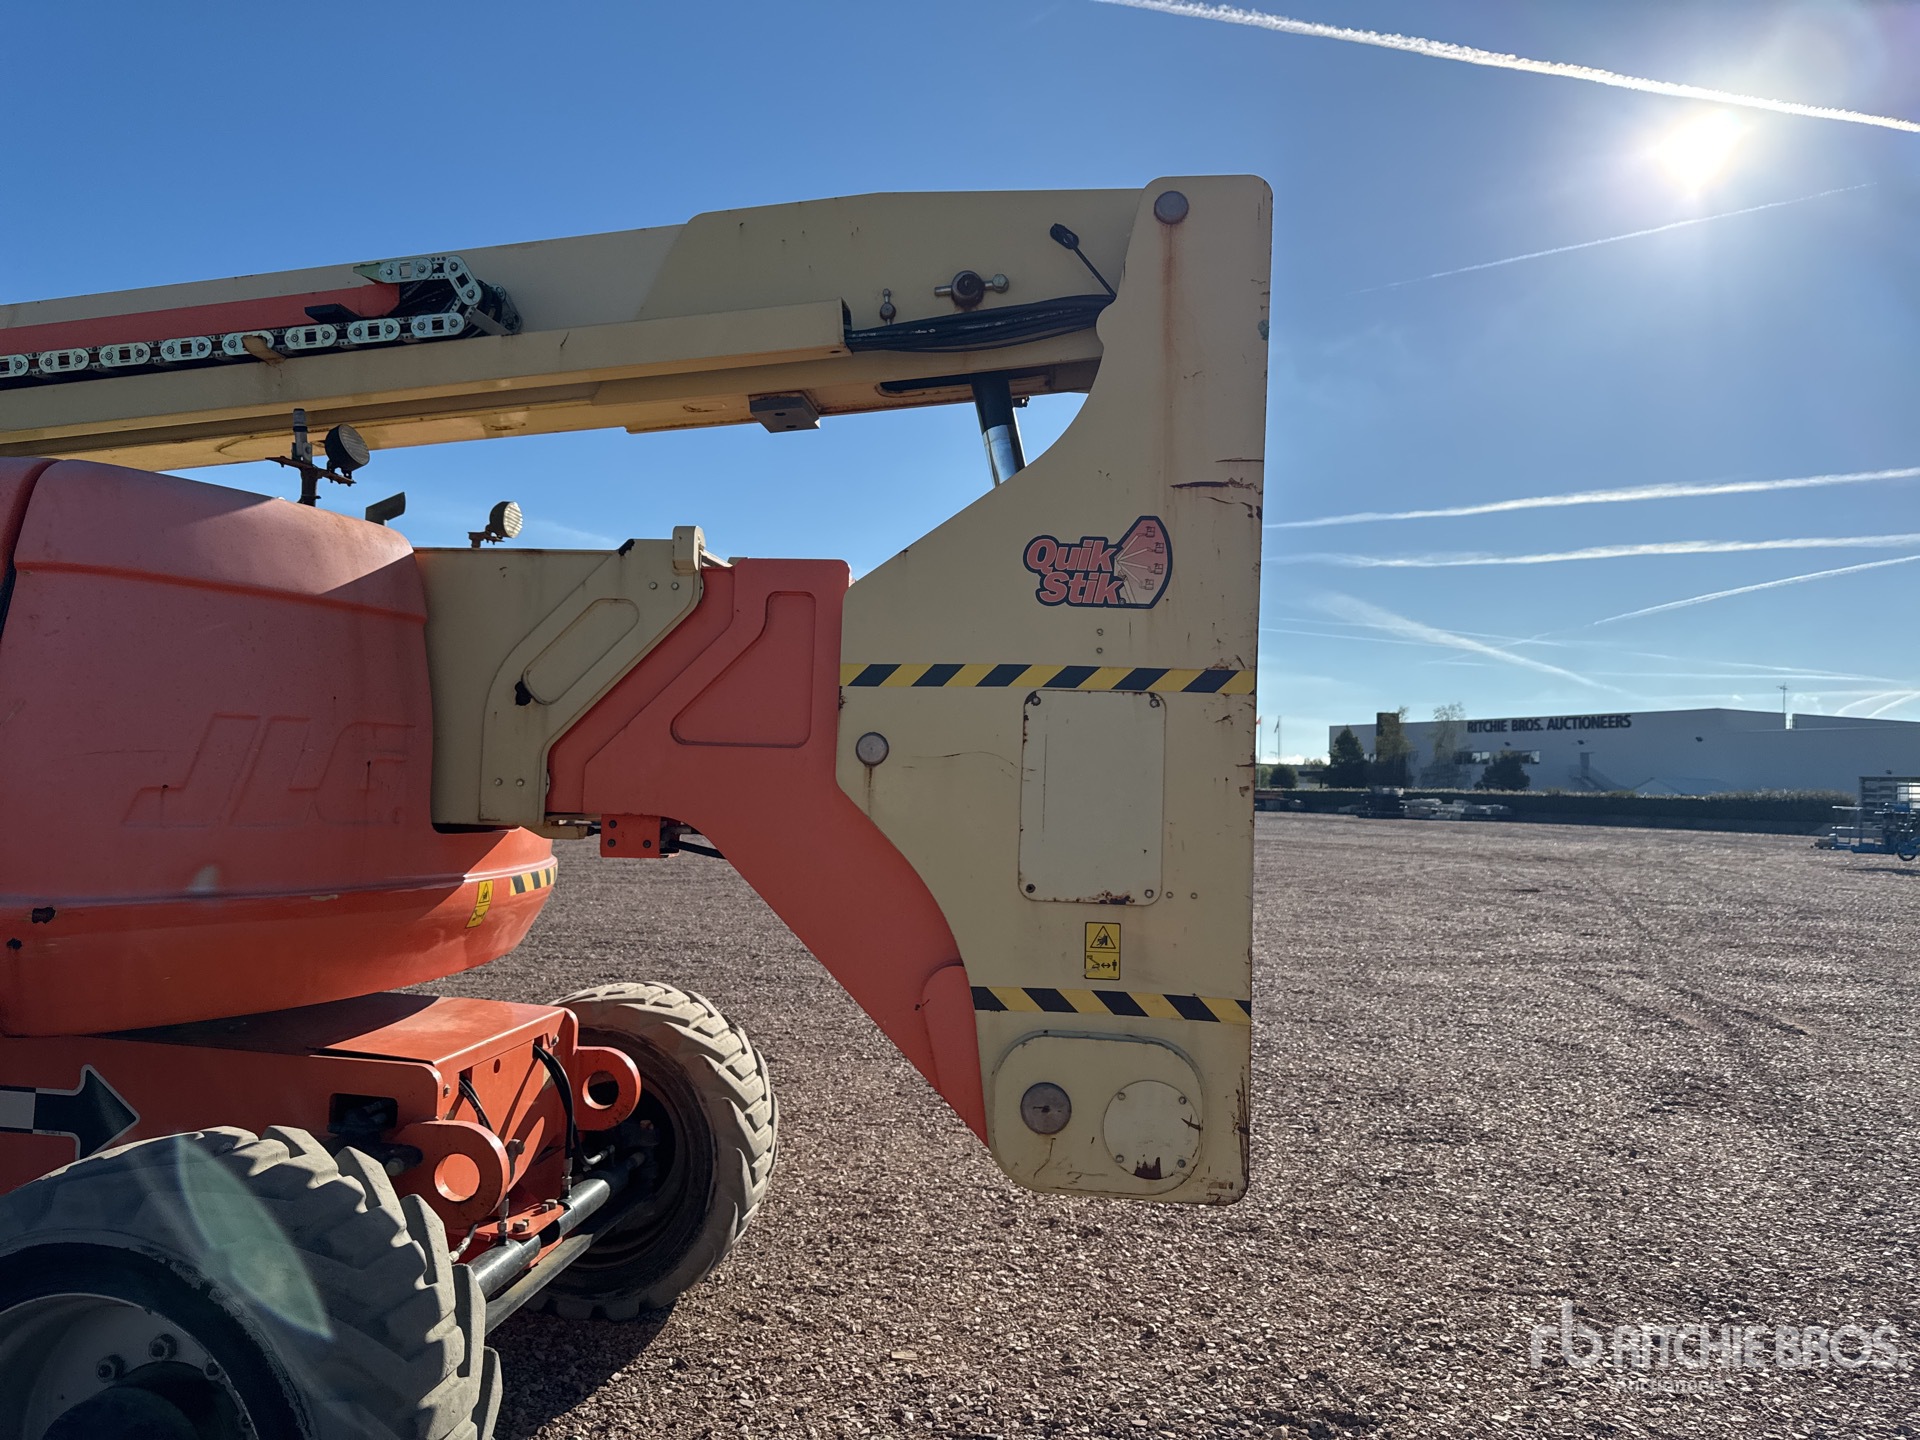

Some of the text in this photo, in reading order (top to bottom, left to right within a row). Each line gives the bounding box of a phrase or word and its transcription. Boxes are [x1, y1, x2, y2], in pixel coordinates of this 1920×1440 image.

[1025, 538, 1118, 575] Quik
[1038, 571, 1125, 605] Stik
[1467, 714, 1632, 733] RITCHIE BROS. AUCTIONEERS
